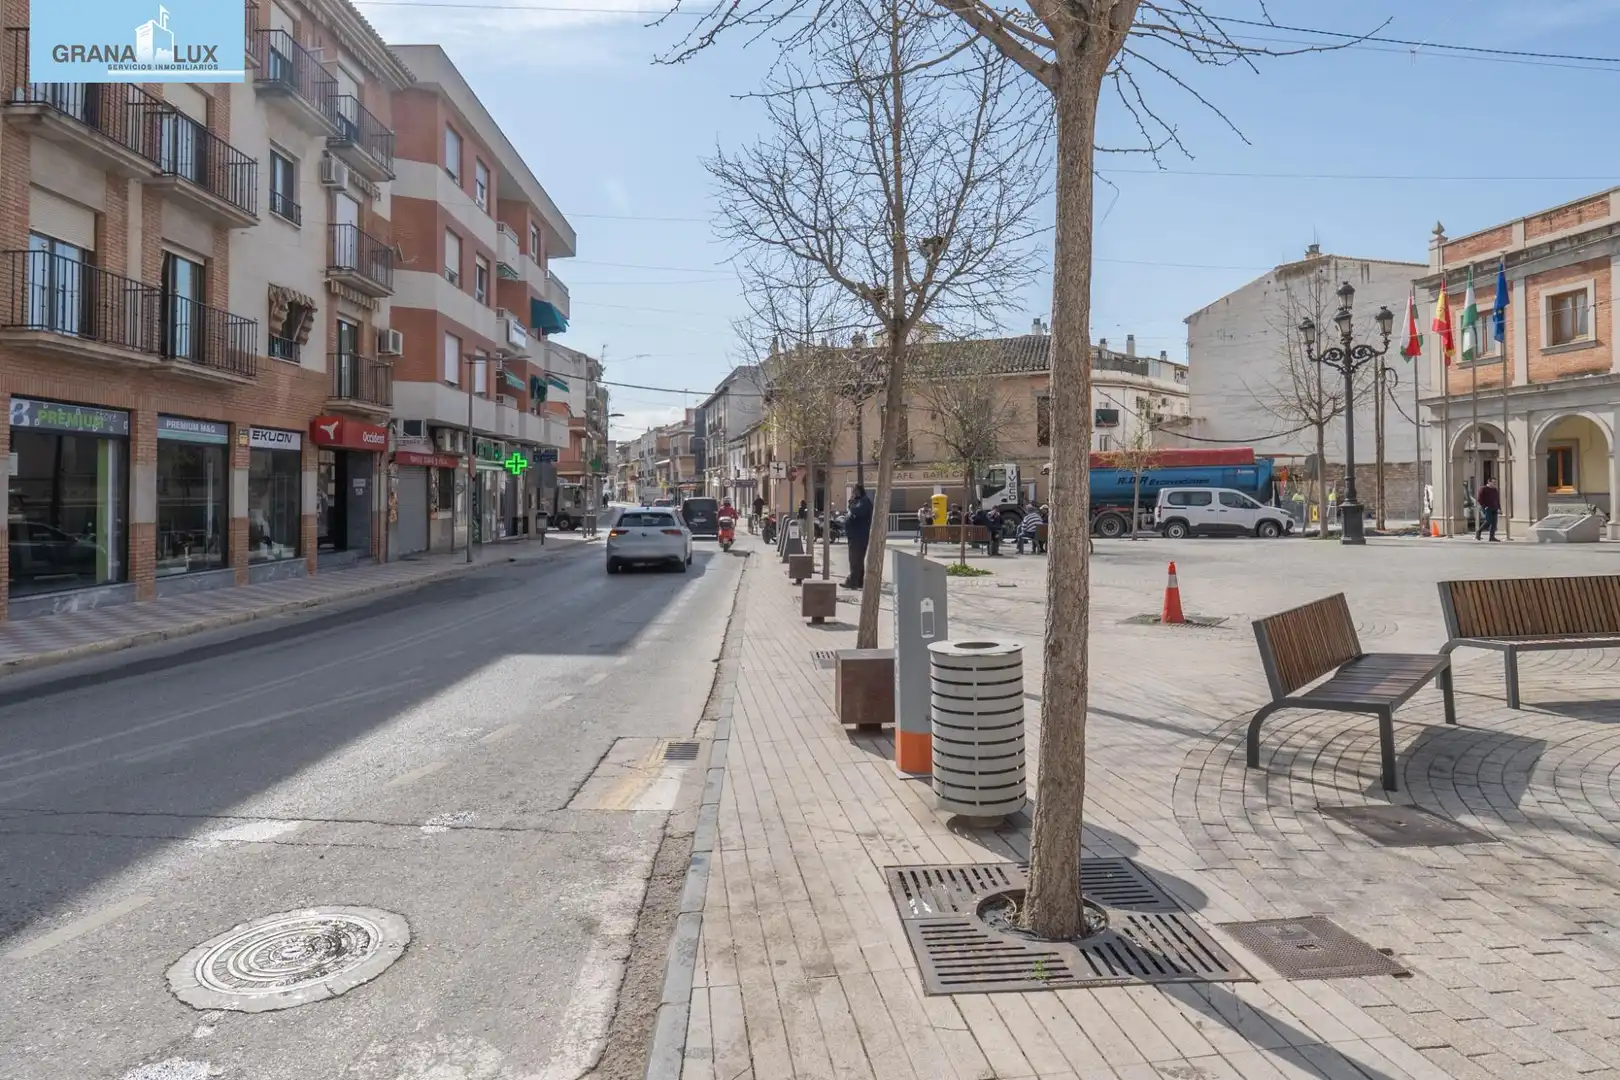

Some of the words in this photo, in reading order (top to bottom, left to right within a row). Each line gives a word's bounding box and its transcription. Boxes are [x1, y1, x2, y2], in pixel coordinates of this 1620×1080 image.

[166, 419, 199, 431] PREMIUM
[252, 430, 293, 443] EKUON
[362, 431, 385, 444] Occident
[1008, 469, 1017, 501] IVECO
